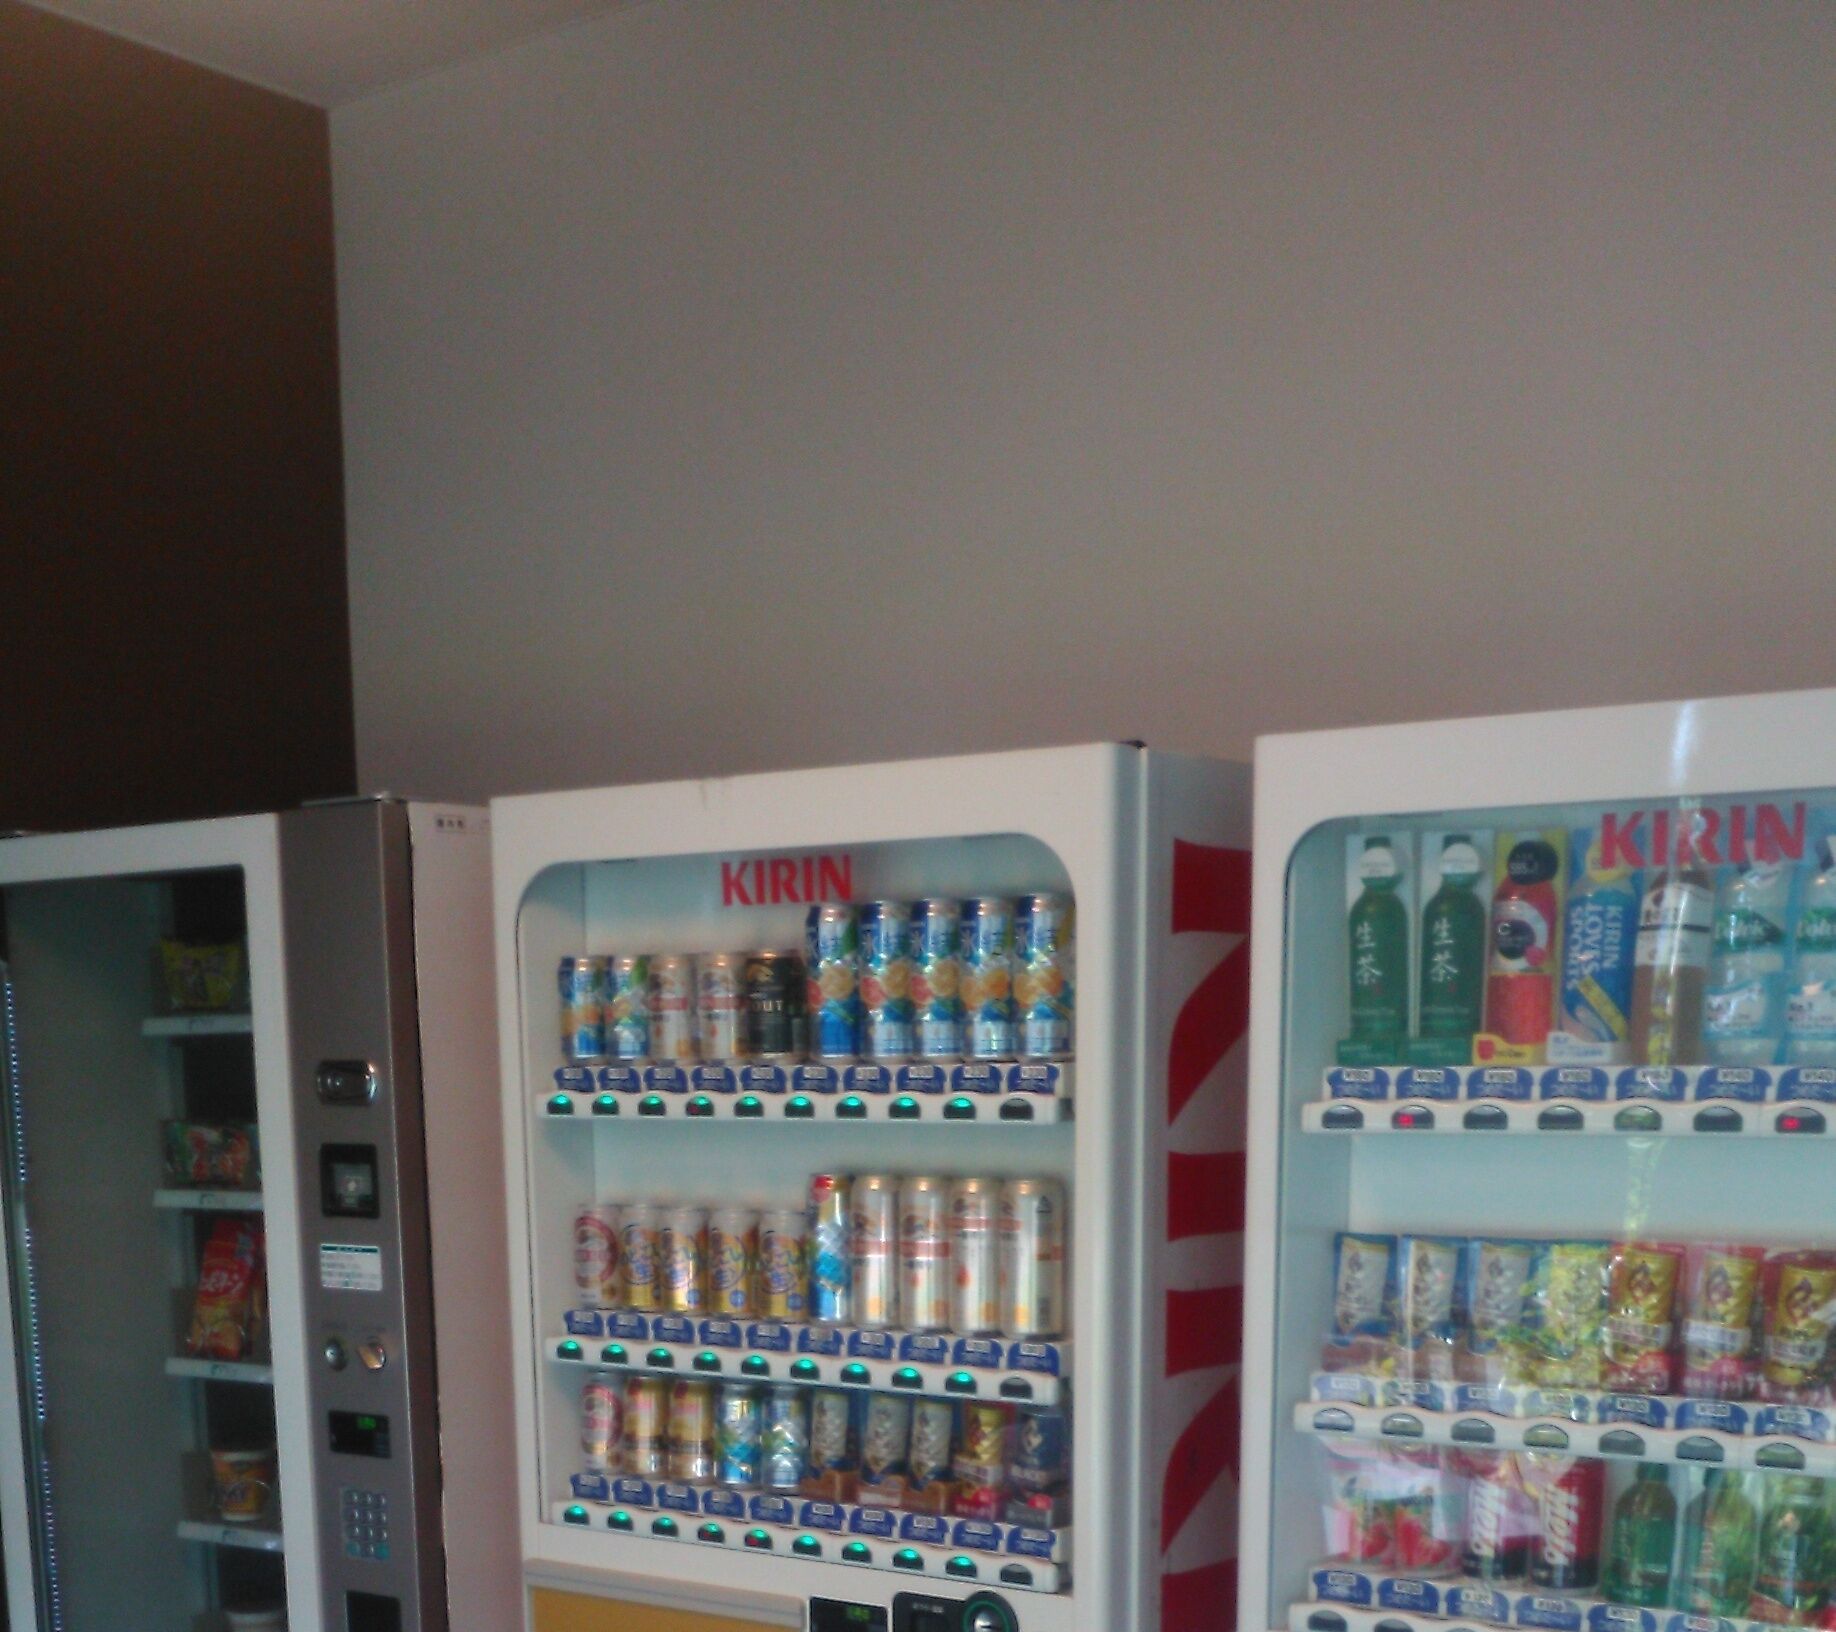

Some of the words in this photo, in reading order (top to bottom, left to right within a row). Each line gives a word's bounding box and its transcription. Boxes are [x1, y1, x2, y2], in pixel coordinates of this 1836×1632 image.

[1601, 802, 1806, 869] KIRIN
[721, 855, 853, 907] KIRIN
[1355, 921, 1382, 985] 生茶
[1431, 917, 1458, 983] 生茶
[1602, 904, 1623, 969] KIRIN
